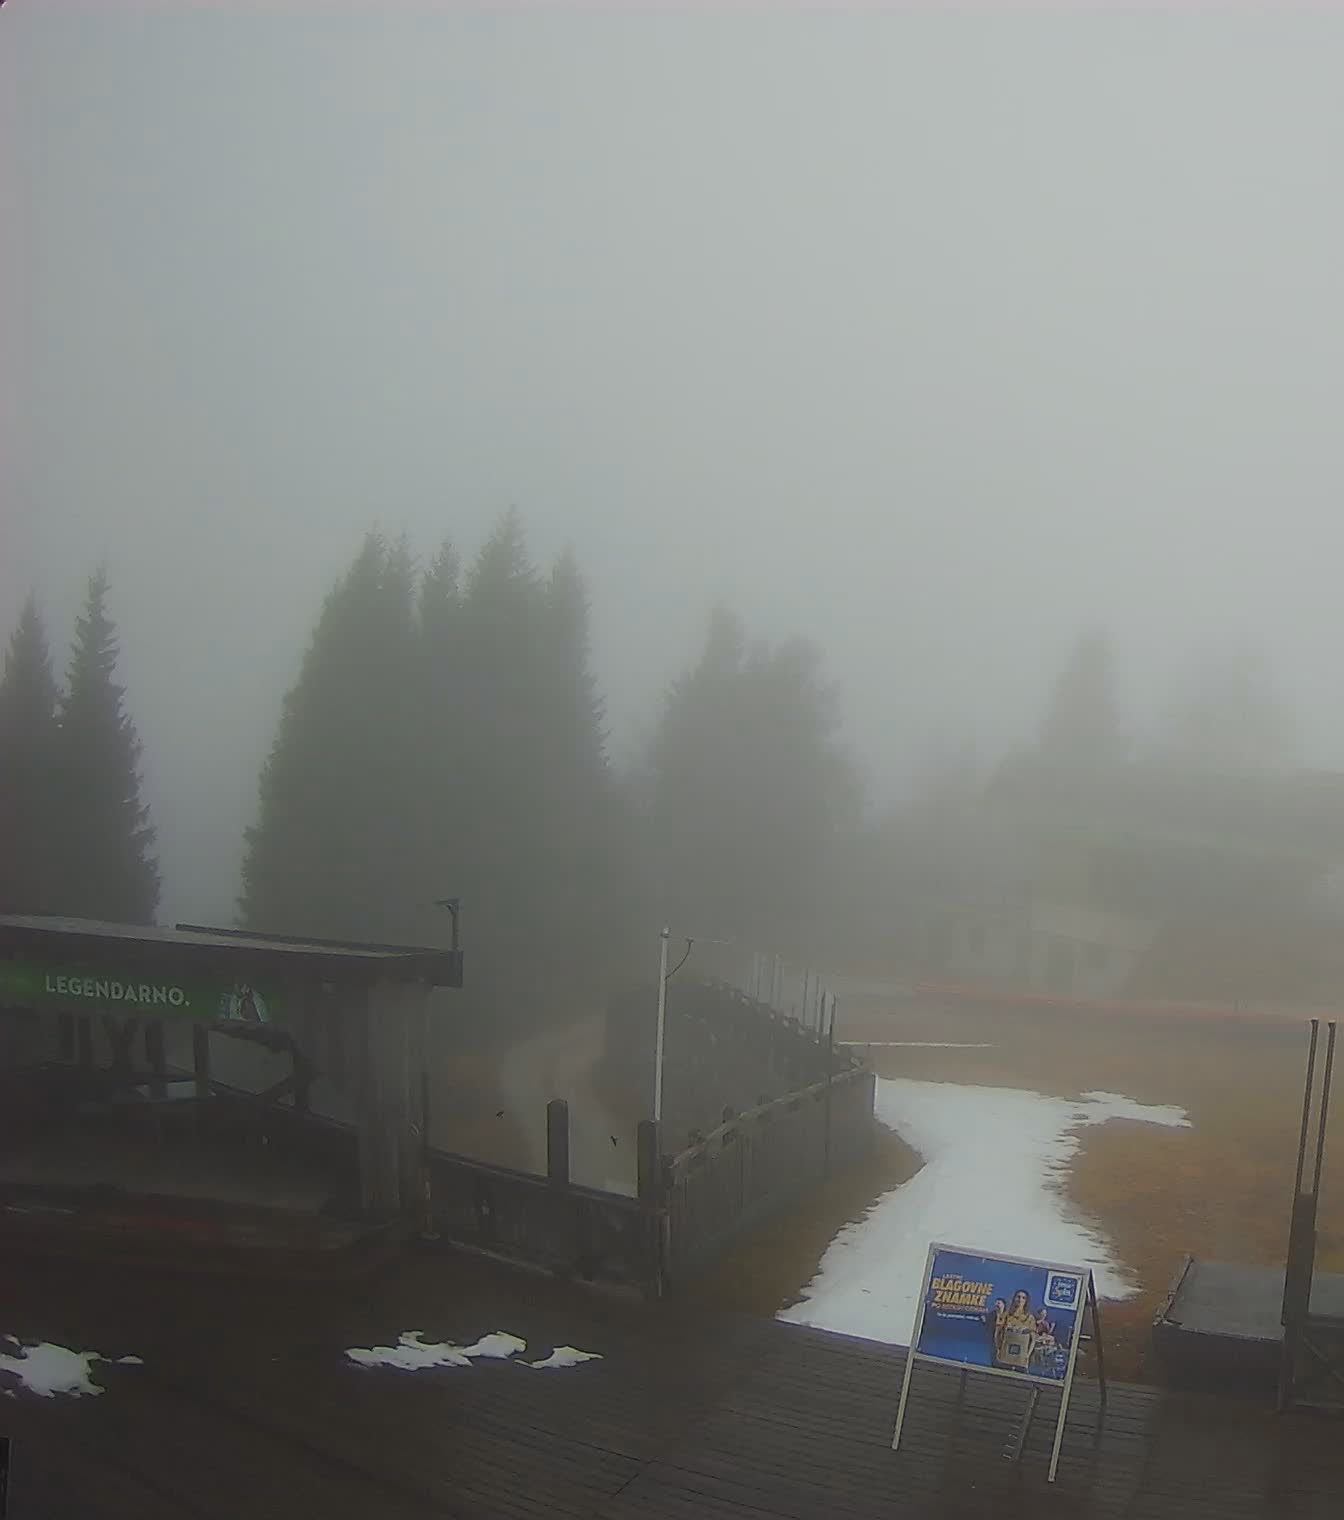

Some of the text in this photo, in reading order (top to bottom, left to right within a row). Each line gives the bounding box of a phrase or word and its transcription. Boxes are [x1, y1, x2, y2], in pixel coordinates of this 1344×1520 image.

[45, 975, 190, 1006] LEGENDARNO.
[932, 1277, 993, 1295] BLAGOVNE
[935, 1290, 987, 1307] ZNAMKE
